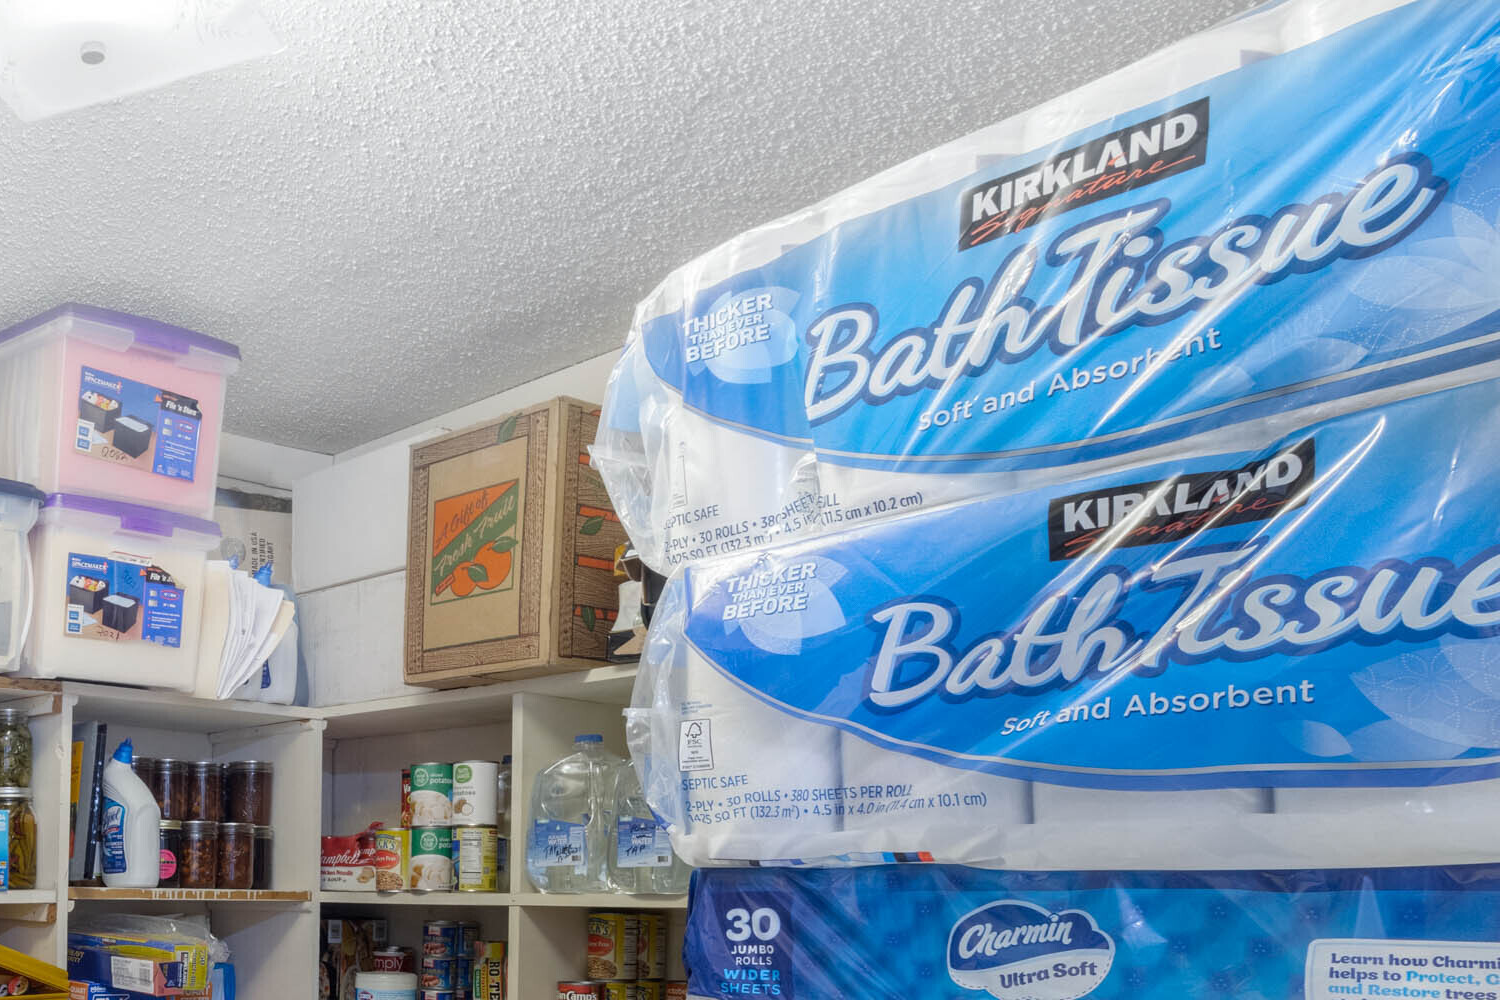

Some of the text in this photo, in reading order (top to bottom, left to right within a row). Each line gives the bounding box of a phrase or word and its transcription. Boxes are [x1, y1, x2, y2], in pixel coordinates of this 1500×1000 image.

[971, 112, 1199, 222] KIRKLAND
[806, 160, 1440, 422] Bath Tissue
[682, 294, 772, 336] THICKER
[686, 325, 771, 363] BEFORE
[918, 326, 1223, 432] Soft and Absorbent
[875, 491, 924, 516] 10.2 cm)
[1063, 453, 1303, 533] KIRKLAND
[694, 504, 720, 523] SAFE
[715, 520, 749, 541] ROLLS
[726, 562, 817, 595] THICKER
[732, 581, 806, 602] THAN EVER
[723, 594, 808, 621] BEFORE
[869, 543, 1500, 707] Bath Tissue
[1001, 679, 1315, 737] Soft and Absorbent
[682, 774, 749, 792] SEPTIC SAFE
[686, 785, 883, 813] 2-PLY 30 ROLLS 380 SHEETS PER
[963, 792, 988, 808] cm)
[725, 907, 781, 942] 30
[958, 913, 1074, 960] Charmin
[731, 945, 775, 956] JUMBO
[735, 956, 773, 966] ROLLS
[1331, 953, 1500, 970] Learn how Charmi
[723, 968, 781, 982] WIDER
[999, 961, 1099, 991] Ultra Soft
[1329, 967, 1481, 987] helps to Protect,
[720, 982, 781, 996] SHEETS
[1328, 983, 1498, 1000] and Restore trees
